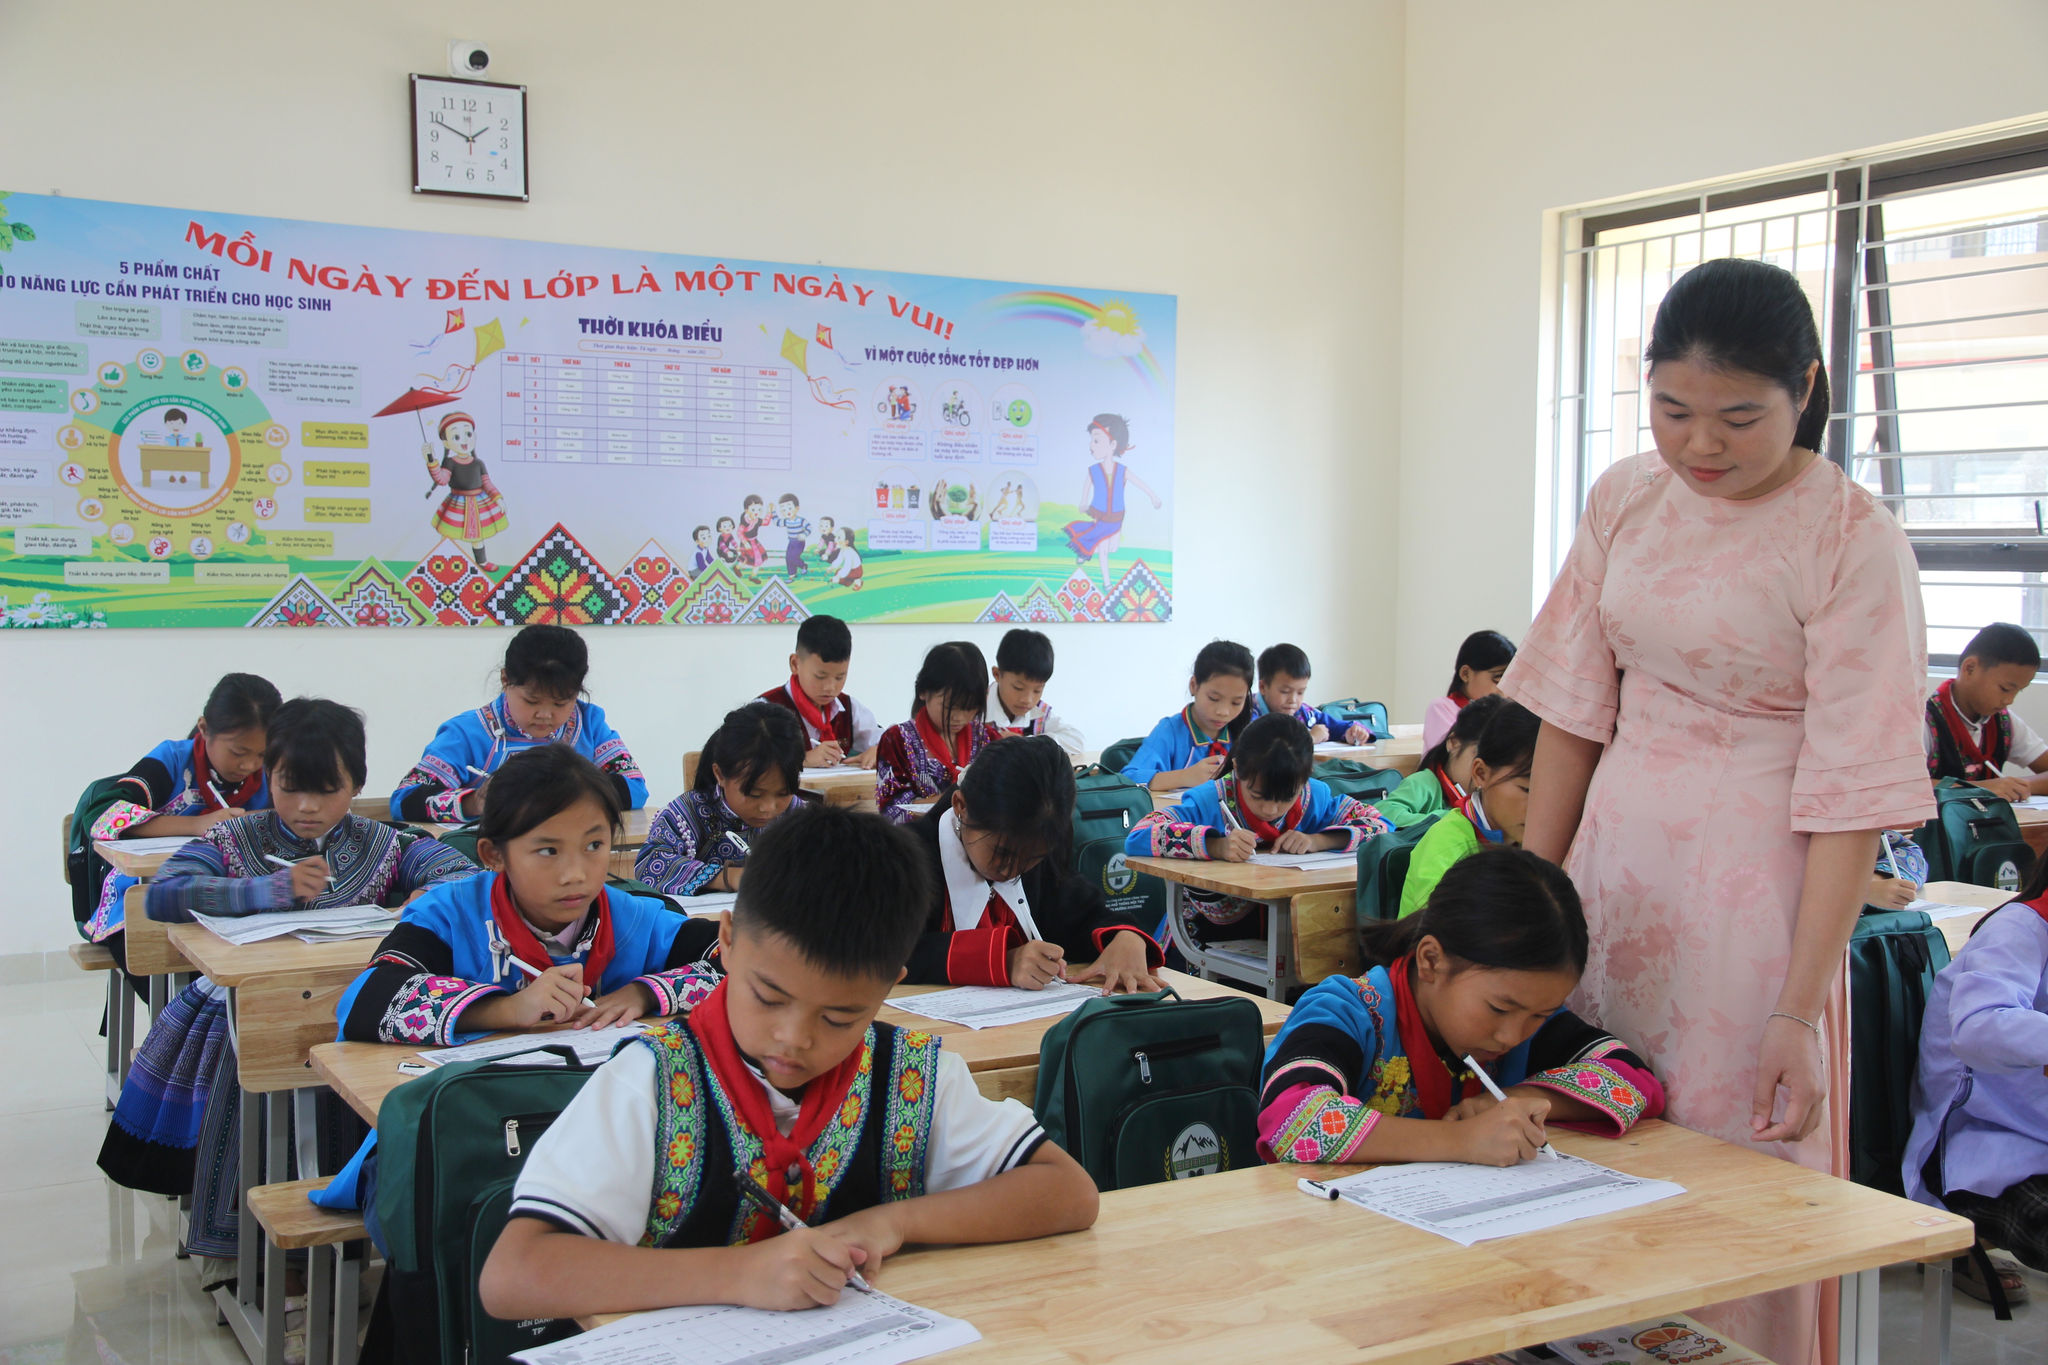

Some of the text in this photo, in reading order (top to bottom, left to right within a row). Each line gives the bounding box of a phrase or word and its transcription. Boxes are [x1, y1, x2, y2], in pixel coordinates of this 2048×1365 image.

[442, 97, 454, 110] 11
[462, 99, 476, 112] 12
[487, 101, 493, 114] 1
[430, 111, 443, 123] 10
[500, 120, 508, 131] 2
[431, 130, 439, 142] 9
[500, 137, 508, 149] 3
[431, 151, 439, 163] 8
[500, 158, 508, 170] 4
[445, 165, 453, 178] 7
[466, 168, 474, 180] 6
[487, 170, 495, 182] 5
[120, 259, 220, 281] 5 PHẨM CHẤT
[186, 222, 953, 340] MỖI NGÀY ĐẾN LỚP LÀ MỘT NGÀY VUI!
[21, 274, 65, 293] NĂNG
[71, 279, 100, 297] LỰC
[142, 284, 180, 301] PHÁT
[185, 286, 226, 304] TRIỂN
[232, 293, 260, 307] CHO
[266, 295, 292, 311] HỌC
[298, 297, 331, 311] SINH
[579, 315, 722, 342] THỜI KHÓA BIỂU
[256, 500, 273, 508] A B
[261, 508, 268, 517] C
[517, 1320, 533, 1328] LIÊN
